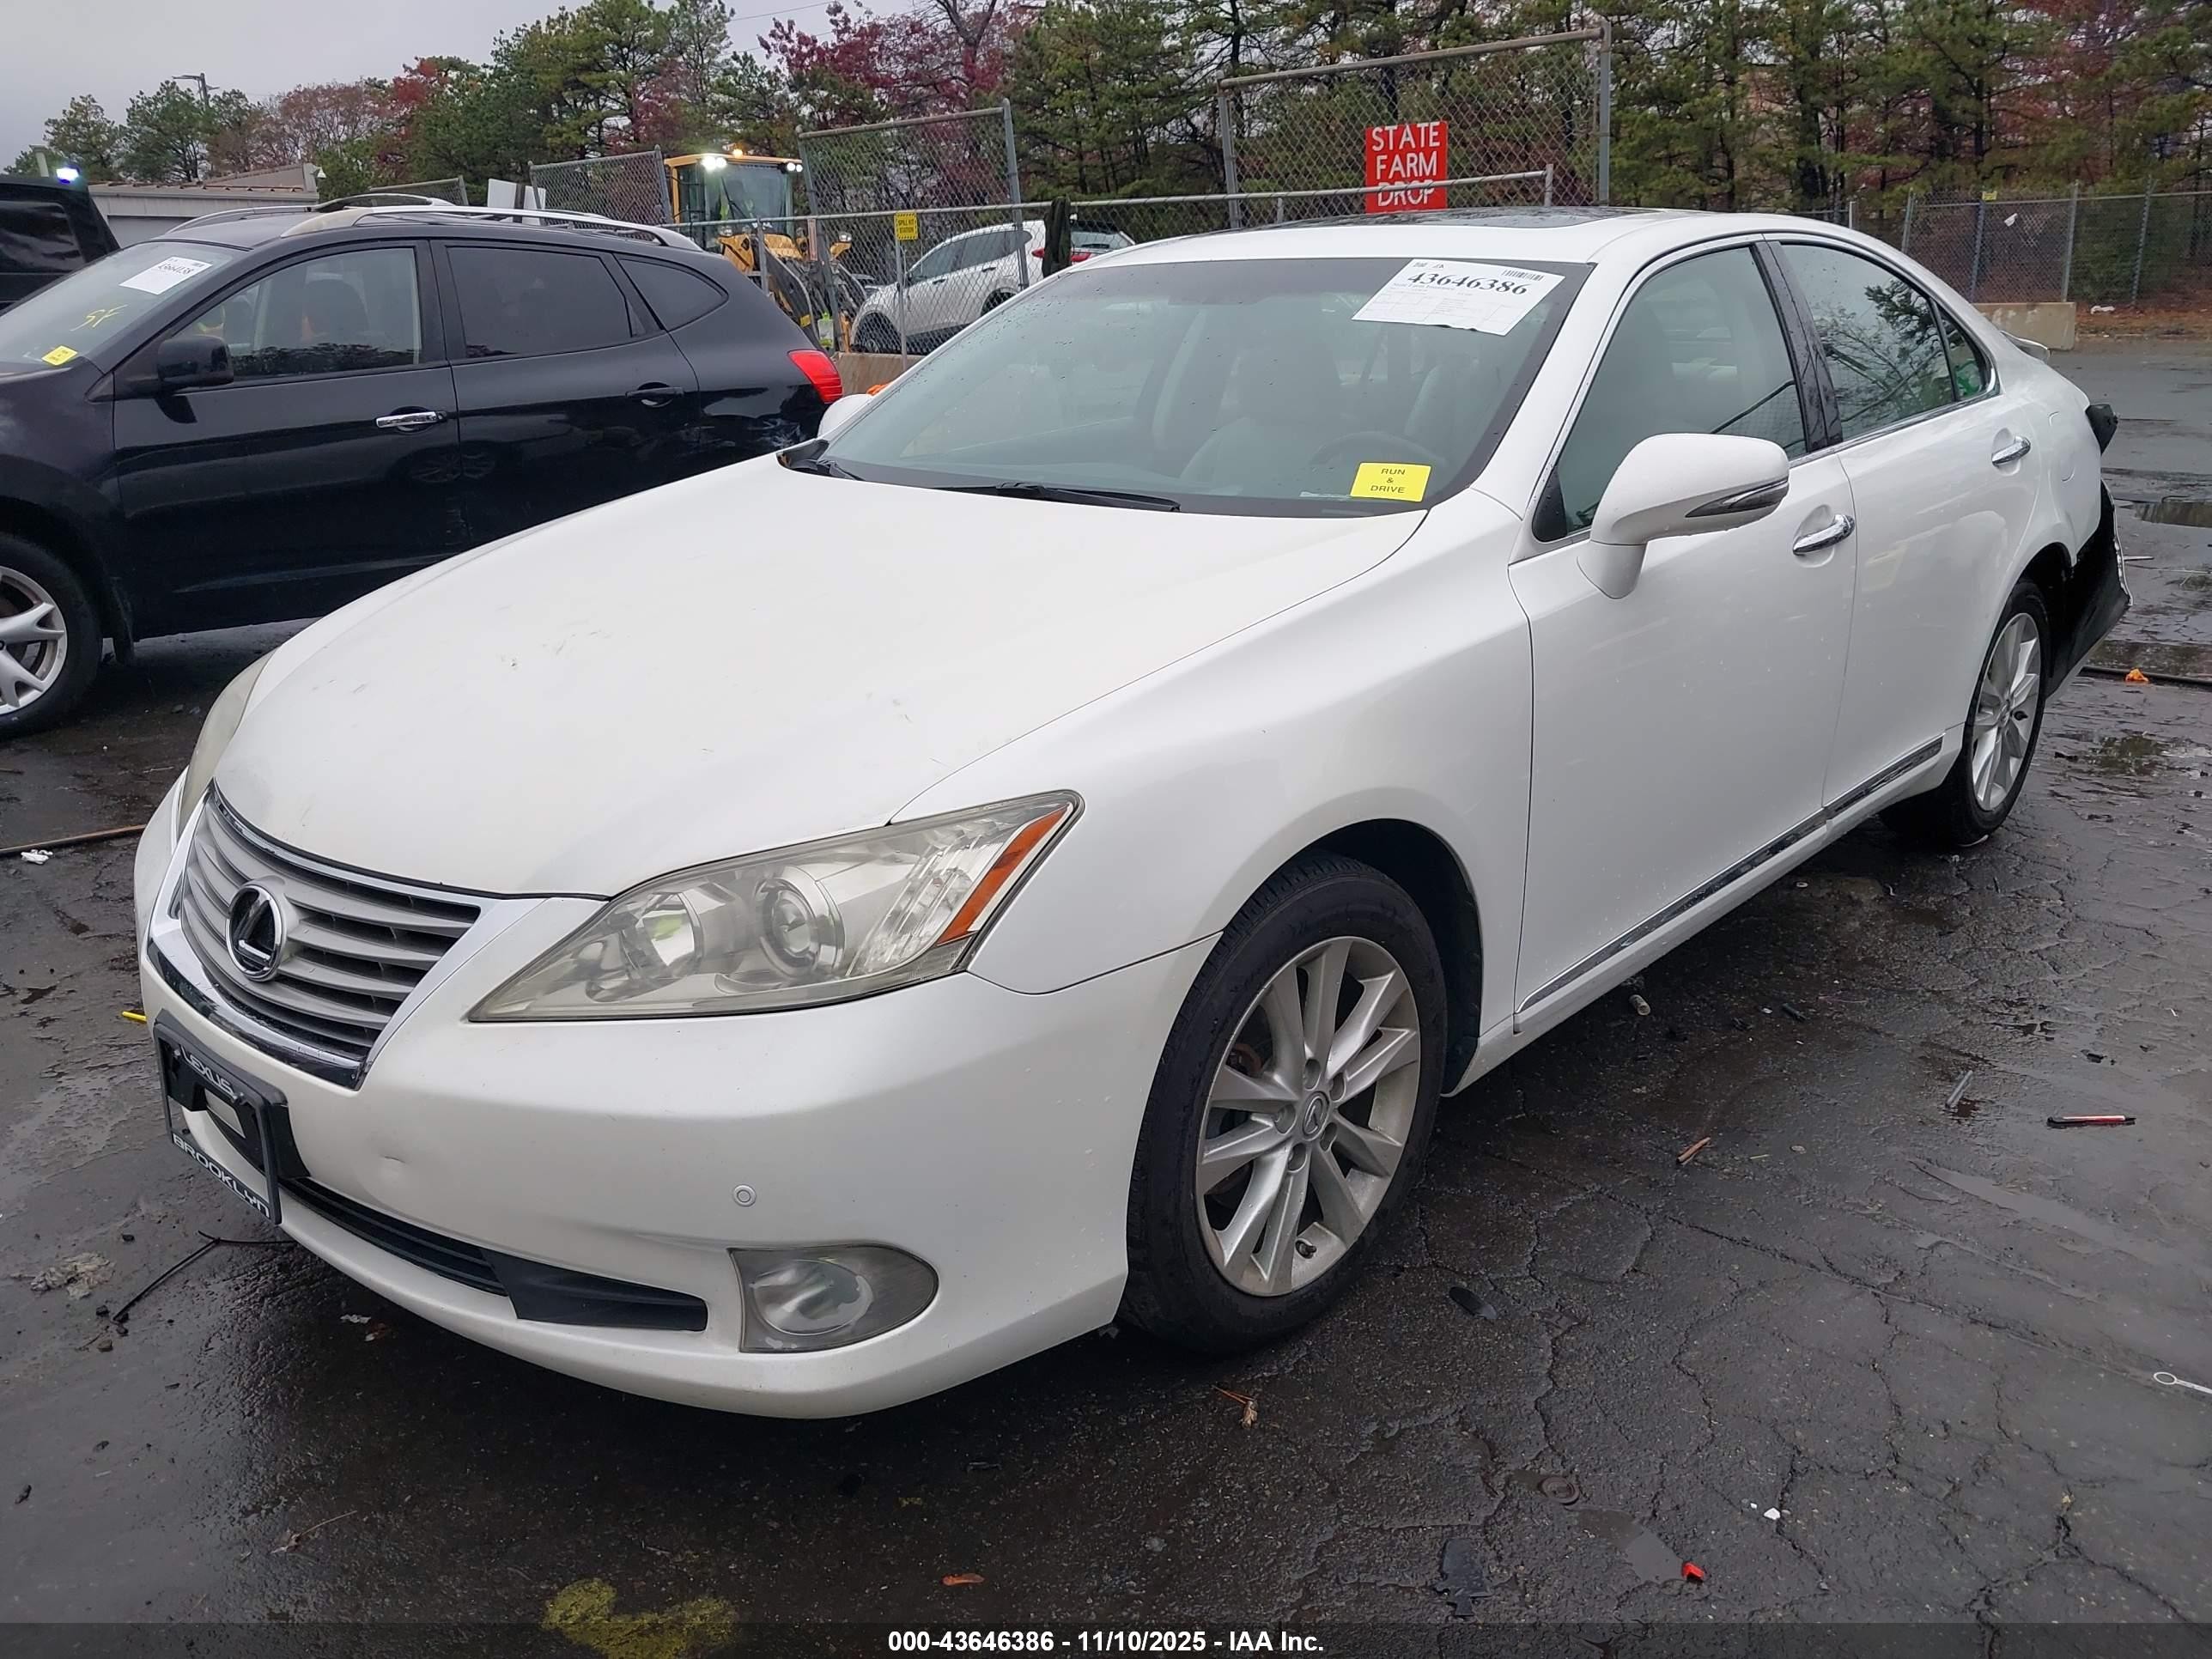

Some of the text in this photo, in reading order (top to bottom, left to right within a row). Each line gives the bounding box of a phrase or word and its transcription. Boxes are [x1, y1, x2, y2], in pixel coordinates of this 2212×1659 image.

[1372, 121, 1440, 151] STATE
[1376, 151, 1437, 179] FARM
[1378, 179, 1434, 206] DROP
[1407, 271, 1532, 295] 43646386
[178, 1043, 237, 1100] LEXUS
[172, 1133, 270, 1218] BROOKLYN
